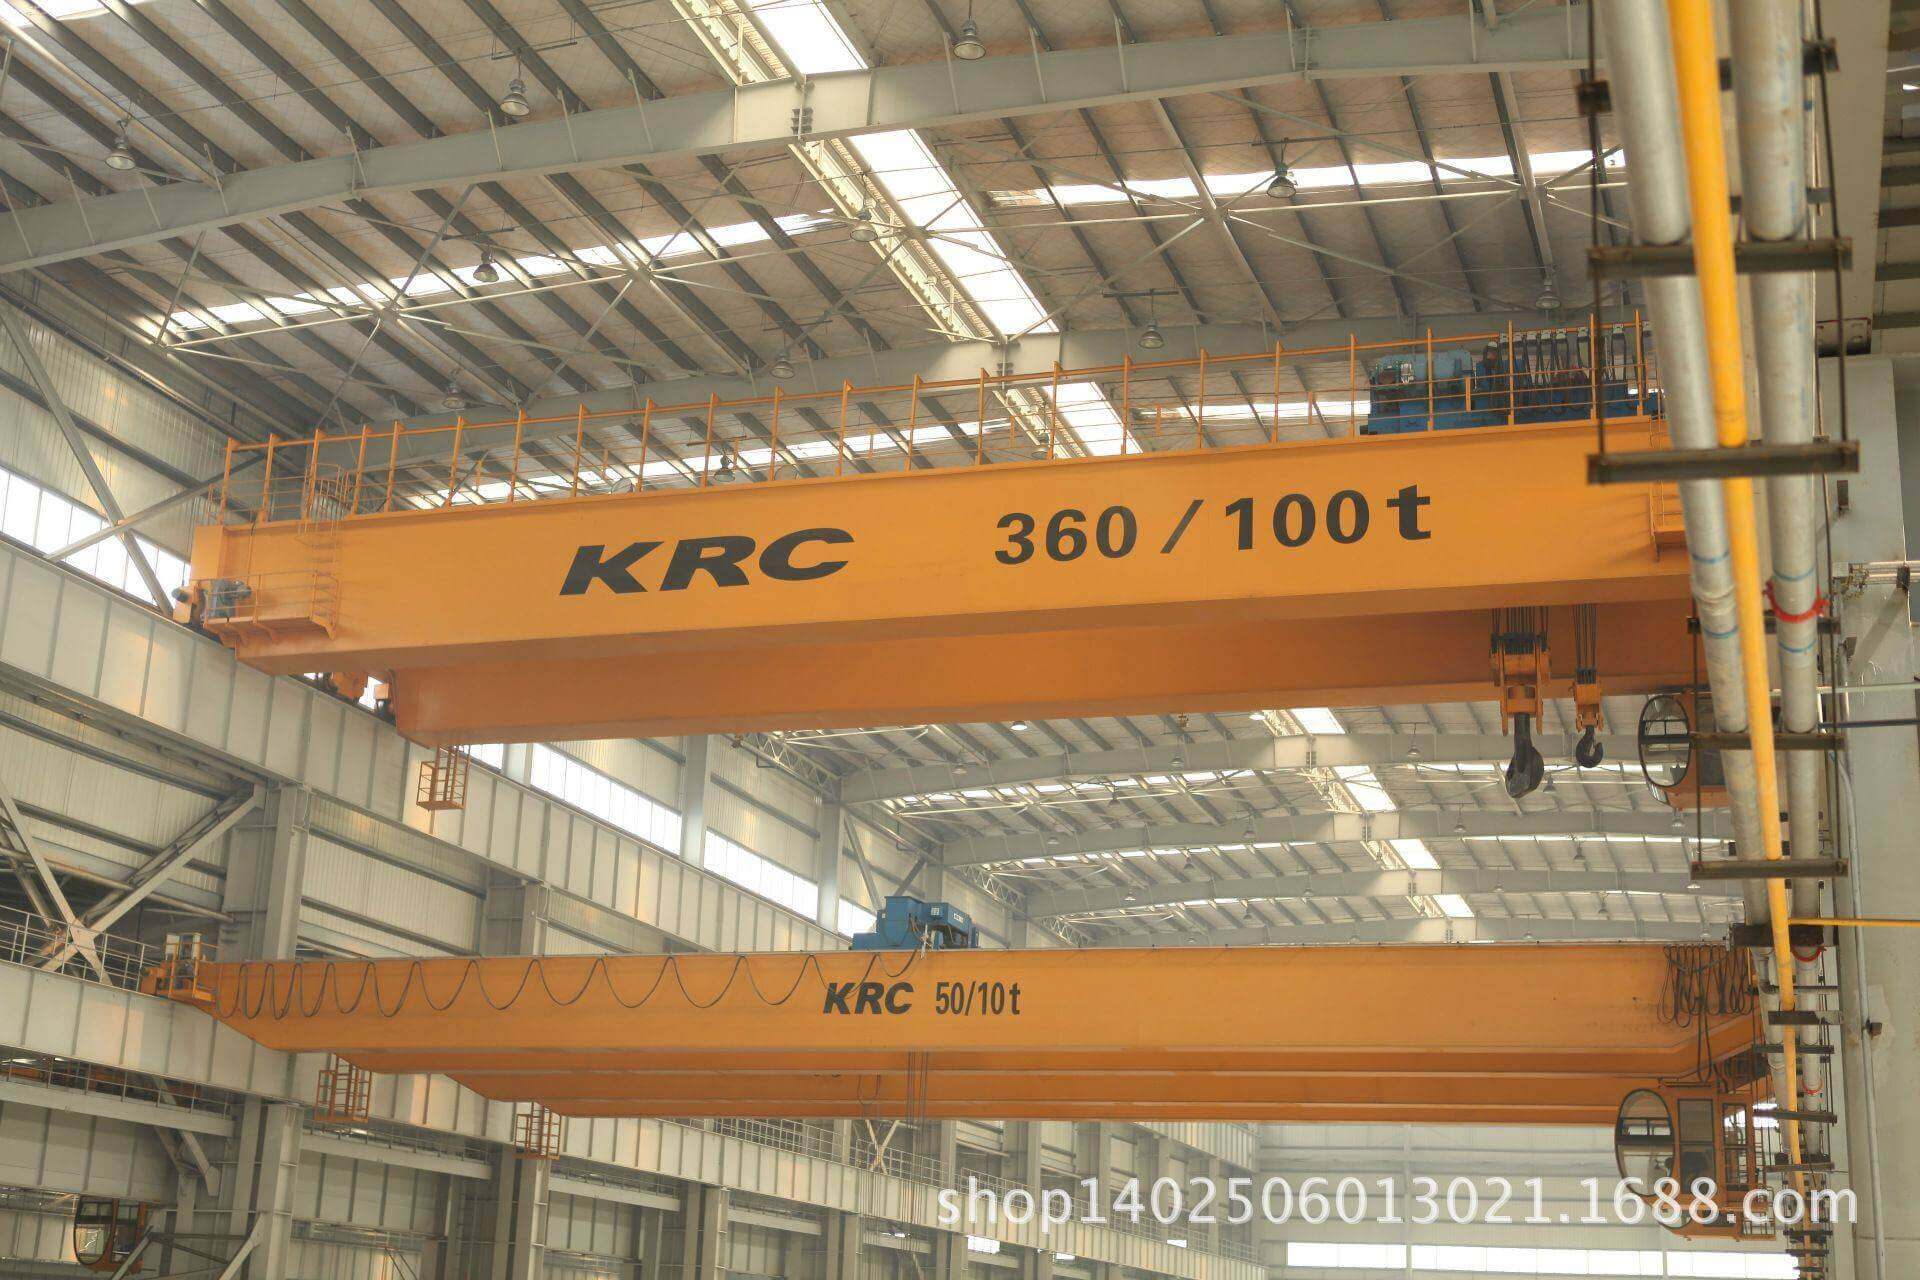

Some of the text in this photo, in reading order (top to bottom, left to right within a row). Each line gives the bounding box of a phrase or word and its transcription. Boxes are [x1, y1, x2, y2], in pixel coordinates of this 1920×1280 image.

[560, 528, 854, 596] KRC
[823, 981, 1021, 1016] KRC 50/10t
